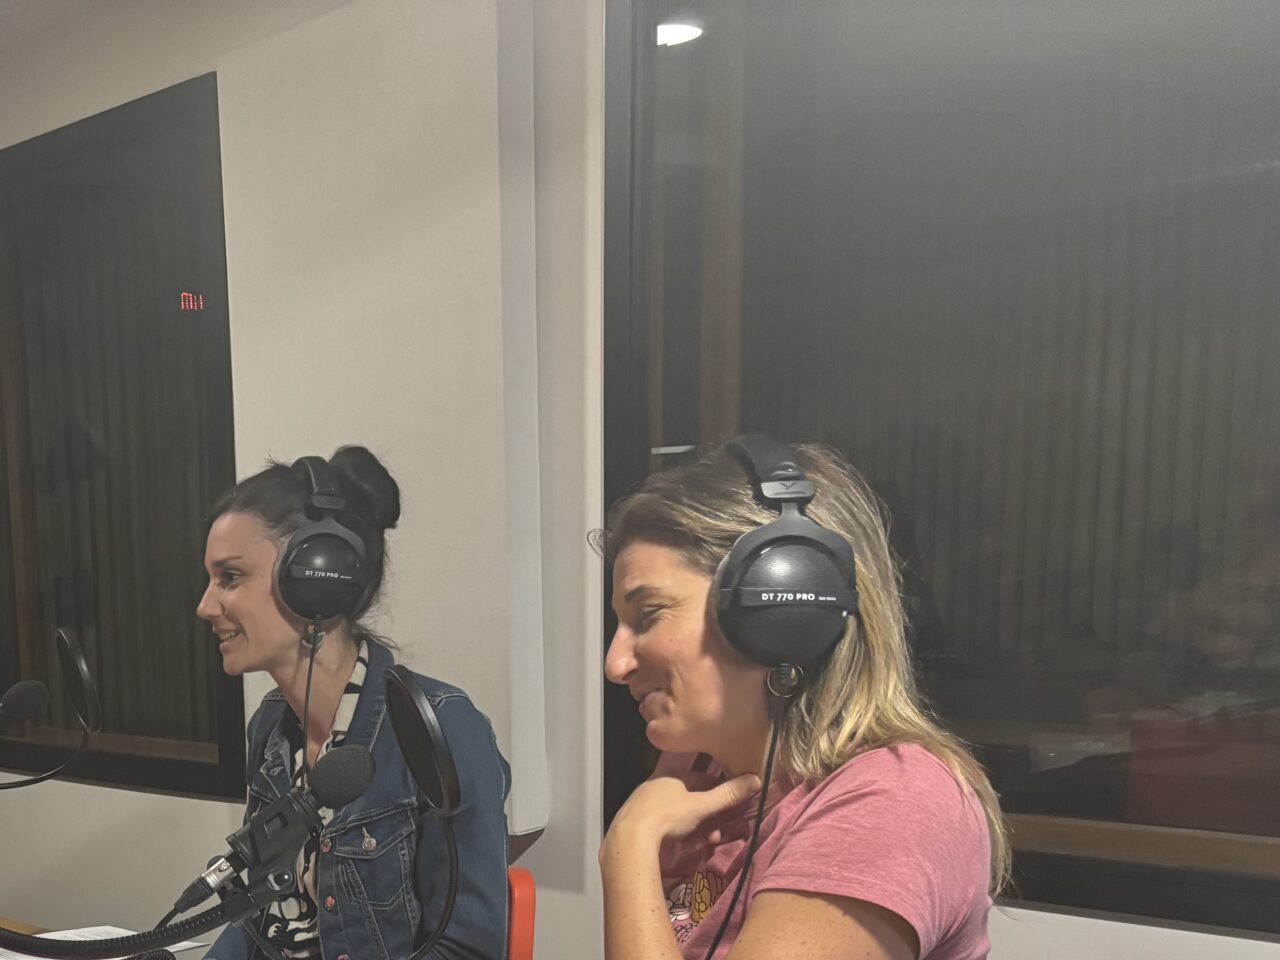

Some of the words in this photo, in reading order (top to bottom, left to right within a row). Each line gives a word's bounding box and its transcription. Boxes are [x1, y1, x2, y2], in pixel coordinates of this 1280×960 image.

[761, 593, 774, 601] DT
[776, 593, 794, 602] 770
[796, 593, 815, 601] PRO
